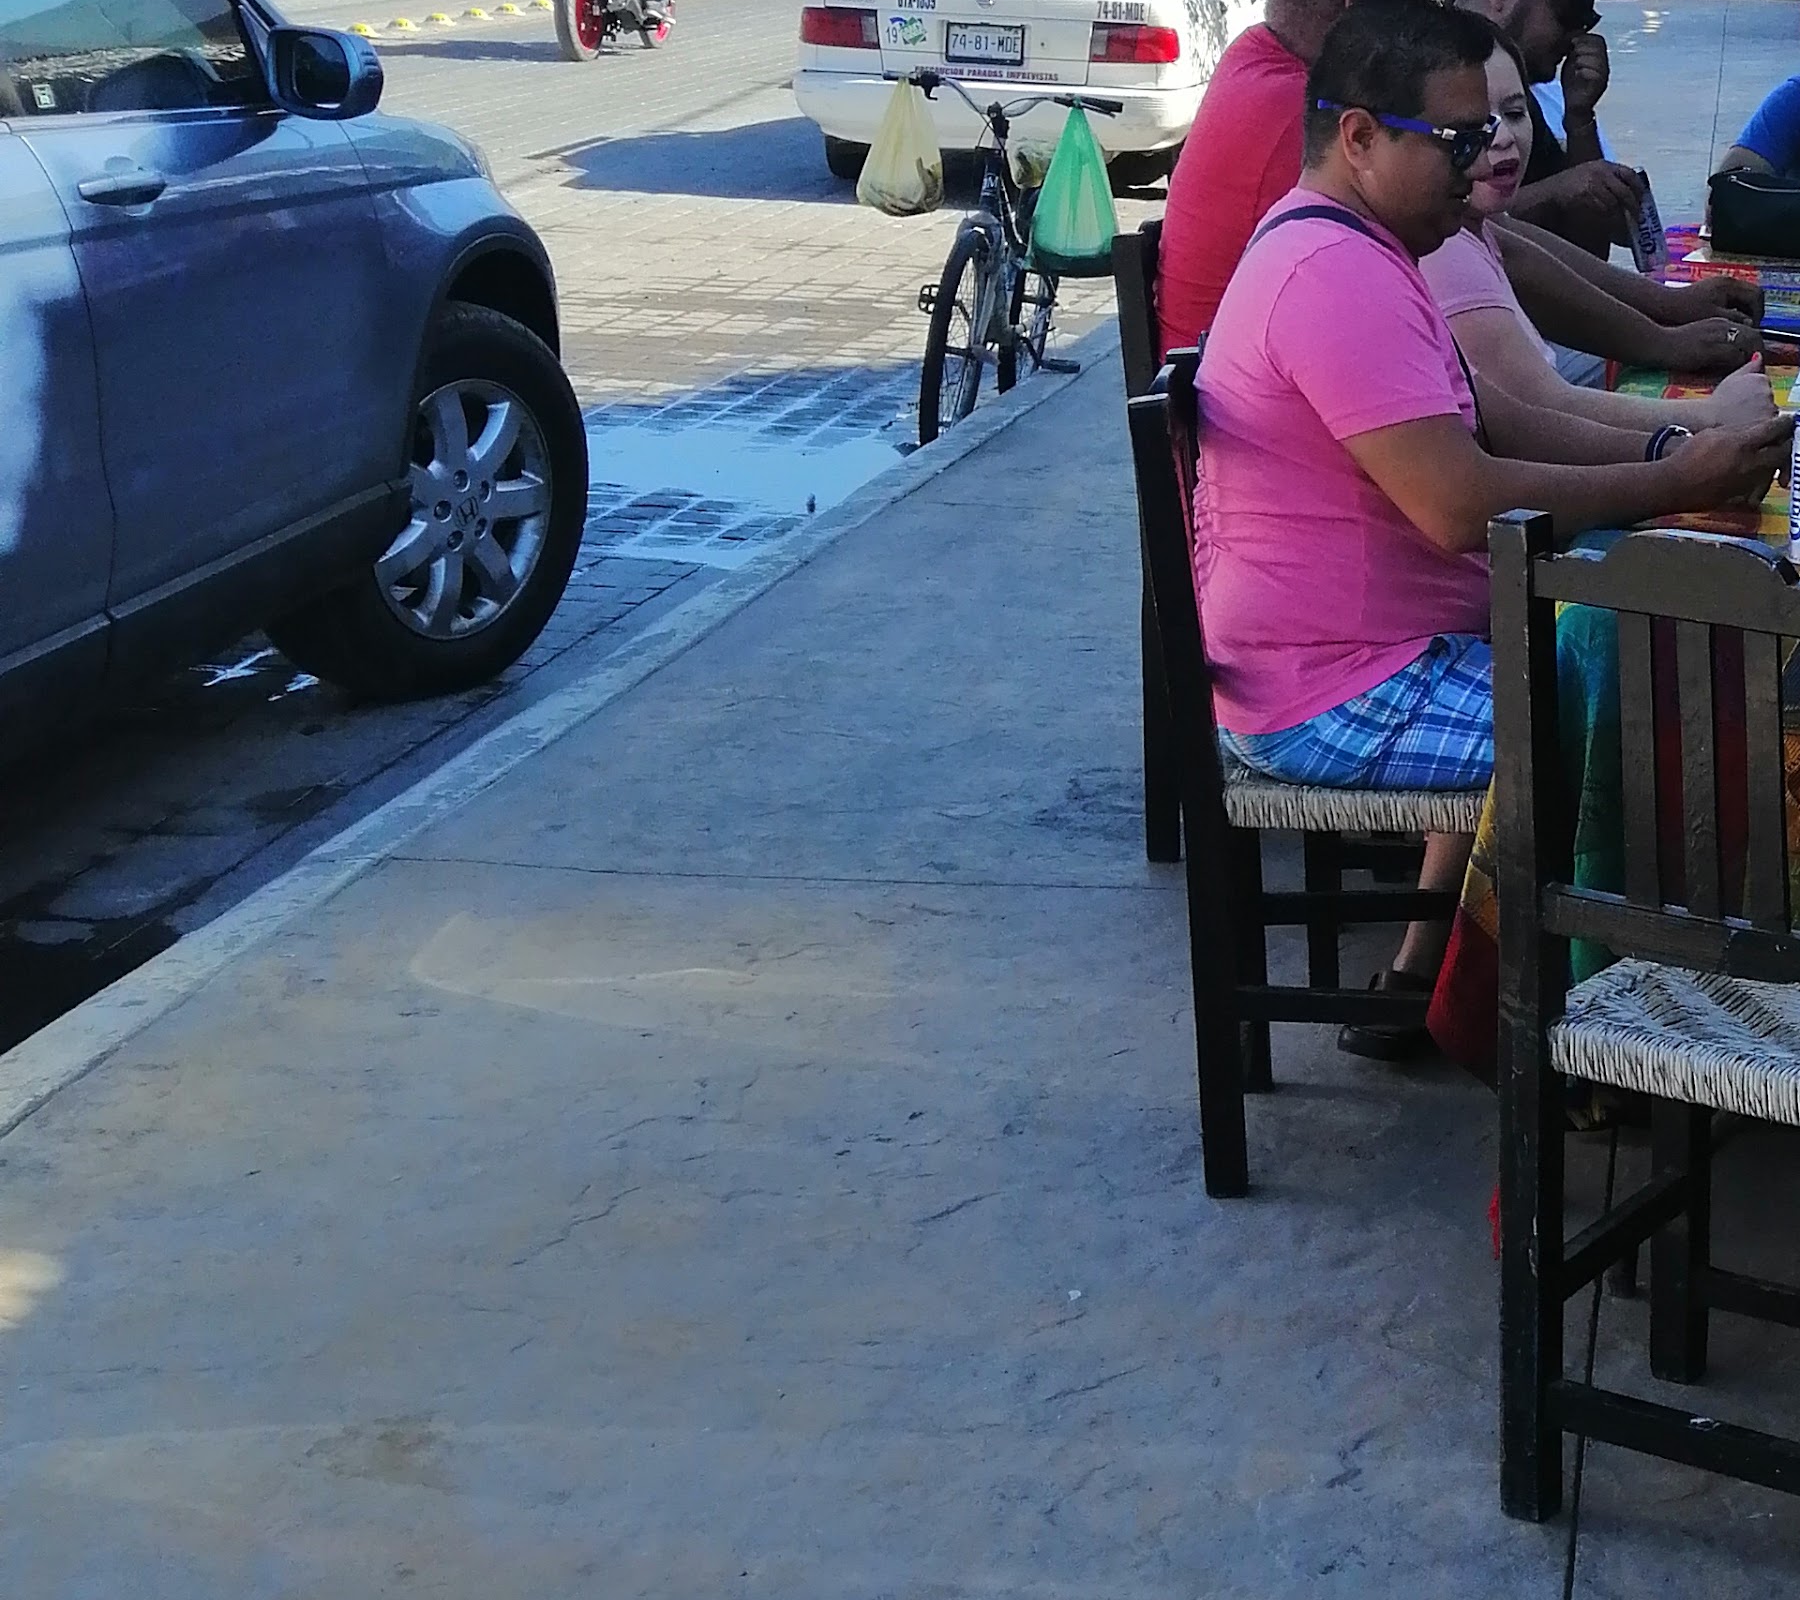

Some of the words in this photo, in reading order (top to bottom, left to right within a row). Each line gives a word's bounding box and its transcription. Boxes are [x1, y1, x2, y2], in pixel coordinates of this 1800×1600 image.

[1096, 0, 1145, 21] 74-81-MDE
[886, 26, 898, 44] 19
[951, 33, 1021, 54] 74-81-MDE
